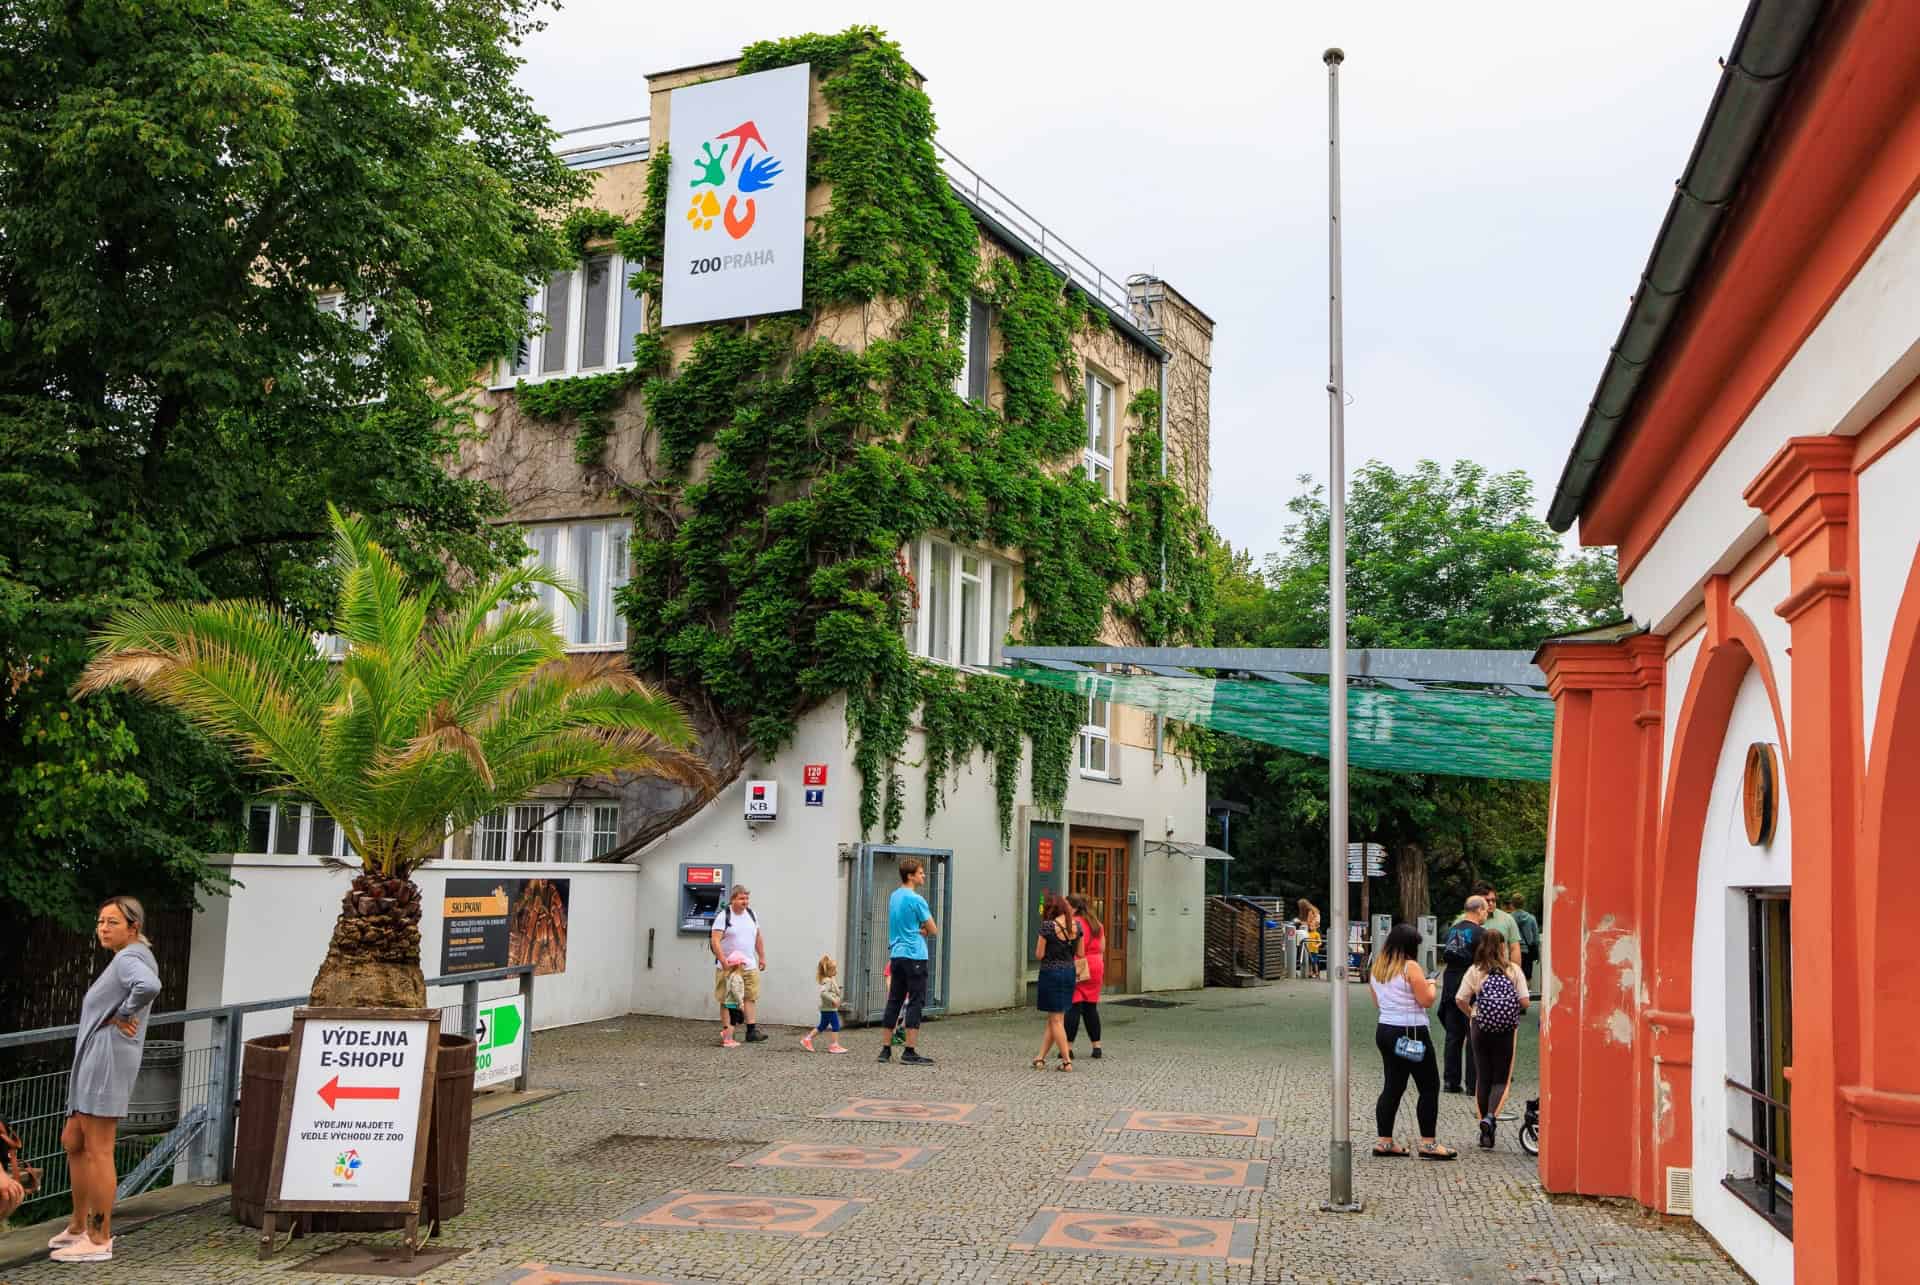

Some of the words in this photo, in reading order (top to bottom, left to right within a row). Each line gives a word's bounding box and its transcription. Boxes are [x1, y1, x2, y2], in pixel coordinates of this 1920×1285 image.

[690, 256, 722, 275] ZOO
[723, 249, 775, 271] PRAHA
[749, 802, 768, 811] KB
[321, 1026, 409, 1047] VÝDEJNA
[320, 1051, 405, 1068] E-SHOPU
[313, 1120, 353, 1130] VÝDEJNU
[355, 1121, 395, 1130] NAJDETE
[301, 1131, 329, 1141] VEDLE
[331, 1130, 372, 1141] VÝCHODU
[373, 1132, 385, 1141] ZE
[386, 1132, 404, 1142] ZOO
